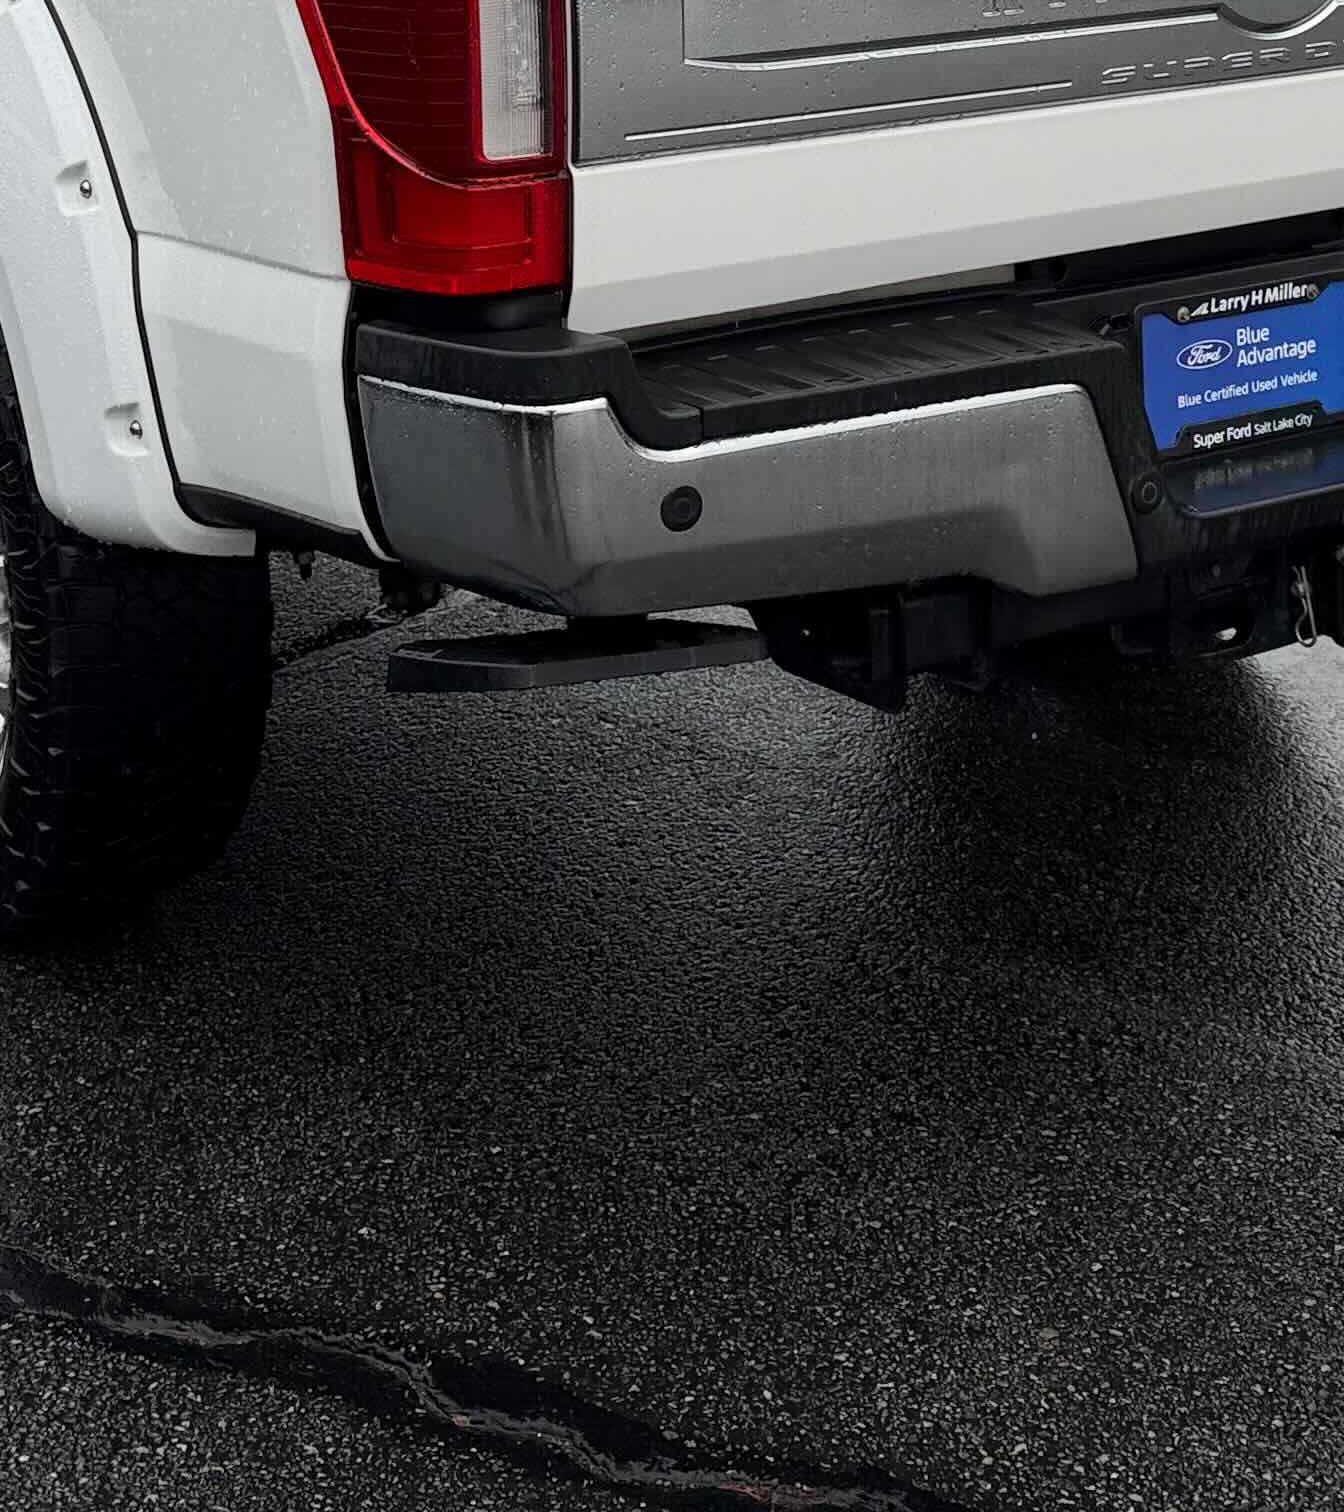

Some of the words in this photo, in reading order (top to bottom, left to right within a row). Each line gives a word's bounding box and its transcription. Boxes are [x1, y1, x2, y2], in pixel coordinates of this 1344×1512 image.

[1101, 46, 1291, 85] SUPER
[1210, 292, 1249, 315] Larry
[1251, 288, 1263, 306] H
[1264, 282, 1308, 303] Miller
[1236, 326, 1270, 347] Blue
[1236, 338, 1317, 368] Advantage
[1177, 393, 1202, 409] Blue
[1204, 382, 1249, 404] Certified
[1251, 378, 1278, 393] Used
[1280, 369, 1318, 388] Vehicle
[1193, 429, 1226, 449] Super
[1226, 422, 1253, 440] Ford
[1254, 421, 1272, 435] Salt
[1272, 416, 1294, 432] Lake
[1294, 411, 1313, 429] City
